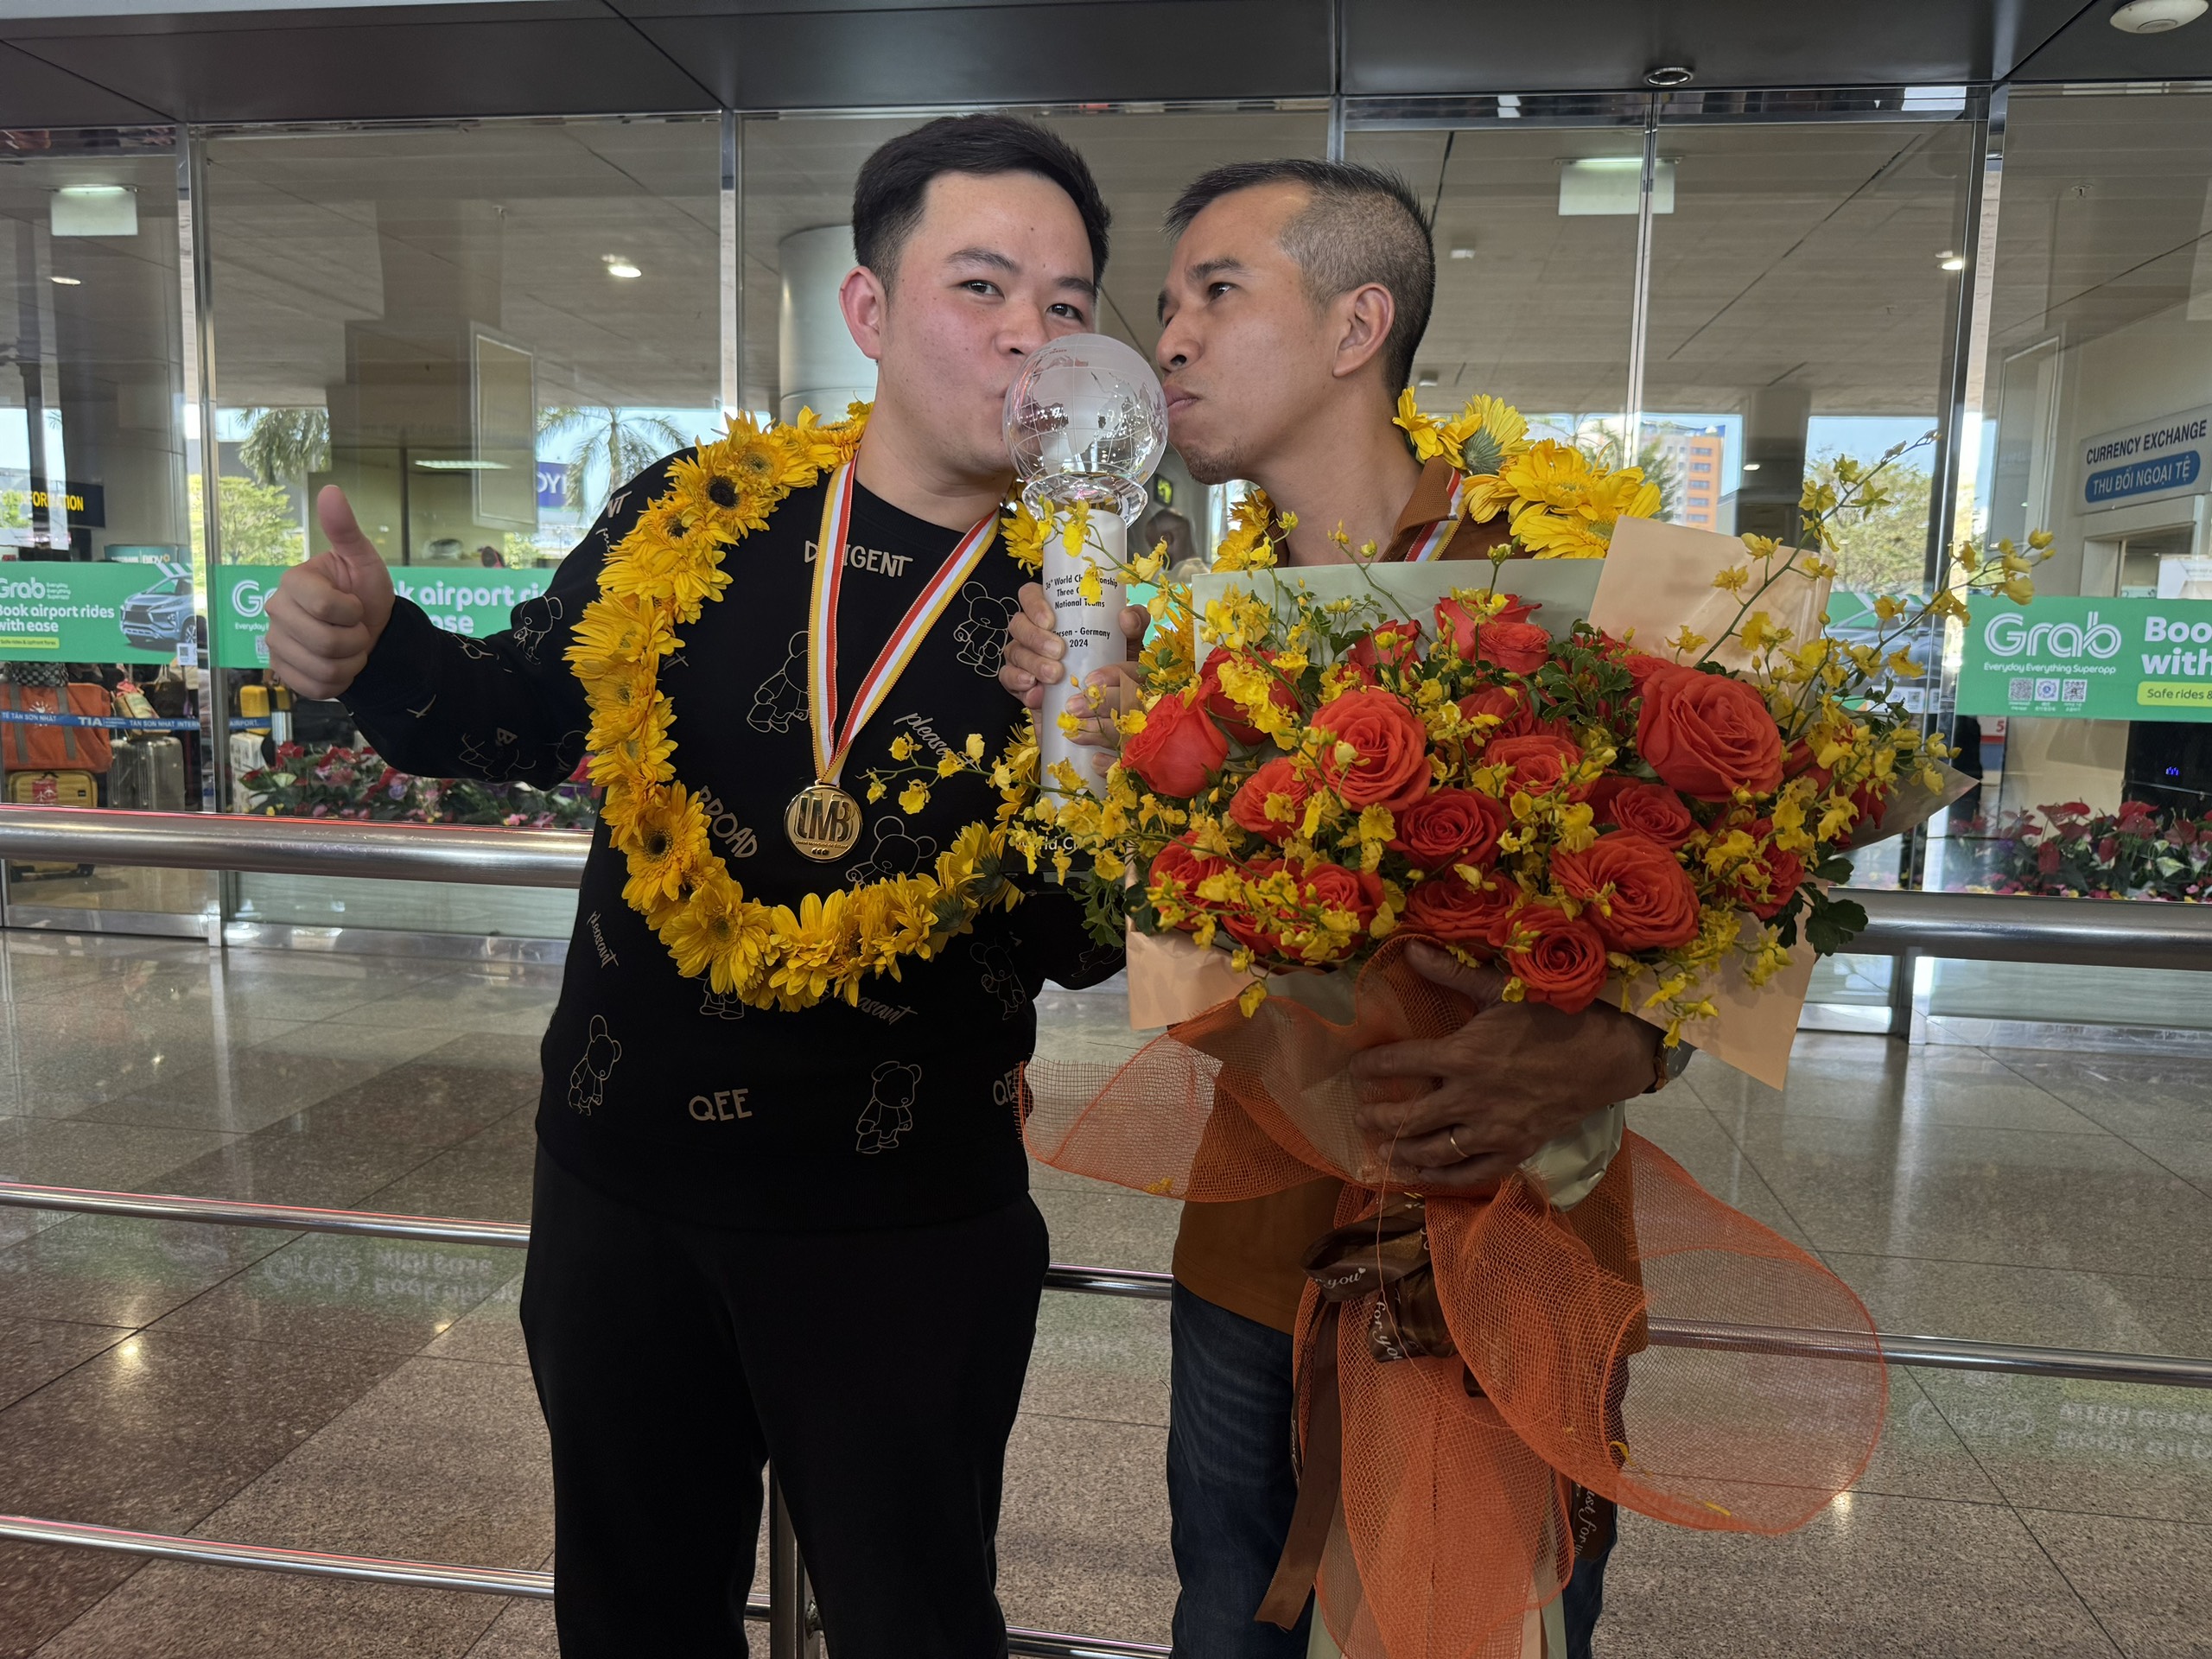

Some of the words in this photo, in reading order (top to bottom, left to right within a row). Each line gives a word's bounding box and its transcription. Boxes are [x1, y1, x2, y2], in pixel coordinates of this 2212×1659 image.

[2086, 436, 2141, 465] CURRENCY
[2143, 419, 2208, 451] EXCHANGE
[2093, 476, 2113, 495] THU
[2115, 467, 2133, 491] ĐỔI
[2136, 463, 2171, 486] NGOẠI
[2175, 455, 2191, 481] TỆ
[804, 540, 913, 577] DIGENT
[1054, 575, 1072, 586] World
[1074, 575, 1118, 588] Chonship
[420, 581, 515, 612] airport
[1057, 588, 1074, 597] Three
[1055, 598, 1082, 609] National
[1084, 598, 1105, 607] Tams
[30, 603, 79, 620] airport
[80, 605, 115, 618] rides
[26, 620, 59, 632] ease
[1080, 626, 1110, 639] Germany
[1984, 611, 2122, 659] Grab
[1069, 639, 1089, 648] 2024
[1984, 662, 2025, 673] Everyday
[2026, 663, 2072, 675] Everything
[2073, 664, 2116, 676] Superapp
[2141, 647, 2212, 676] with
[2147, 688, 2174, 700] Safe
[2176, 689, 2204, 700] rides
[78, 716, 103, 726] TIA
[689, 1088, 753, 1122] QEE
[1323, 1272, 1361, 1289] you
